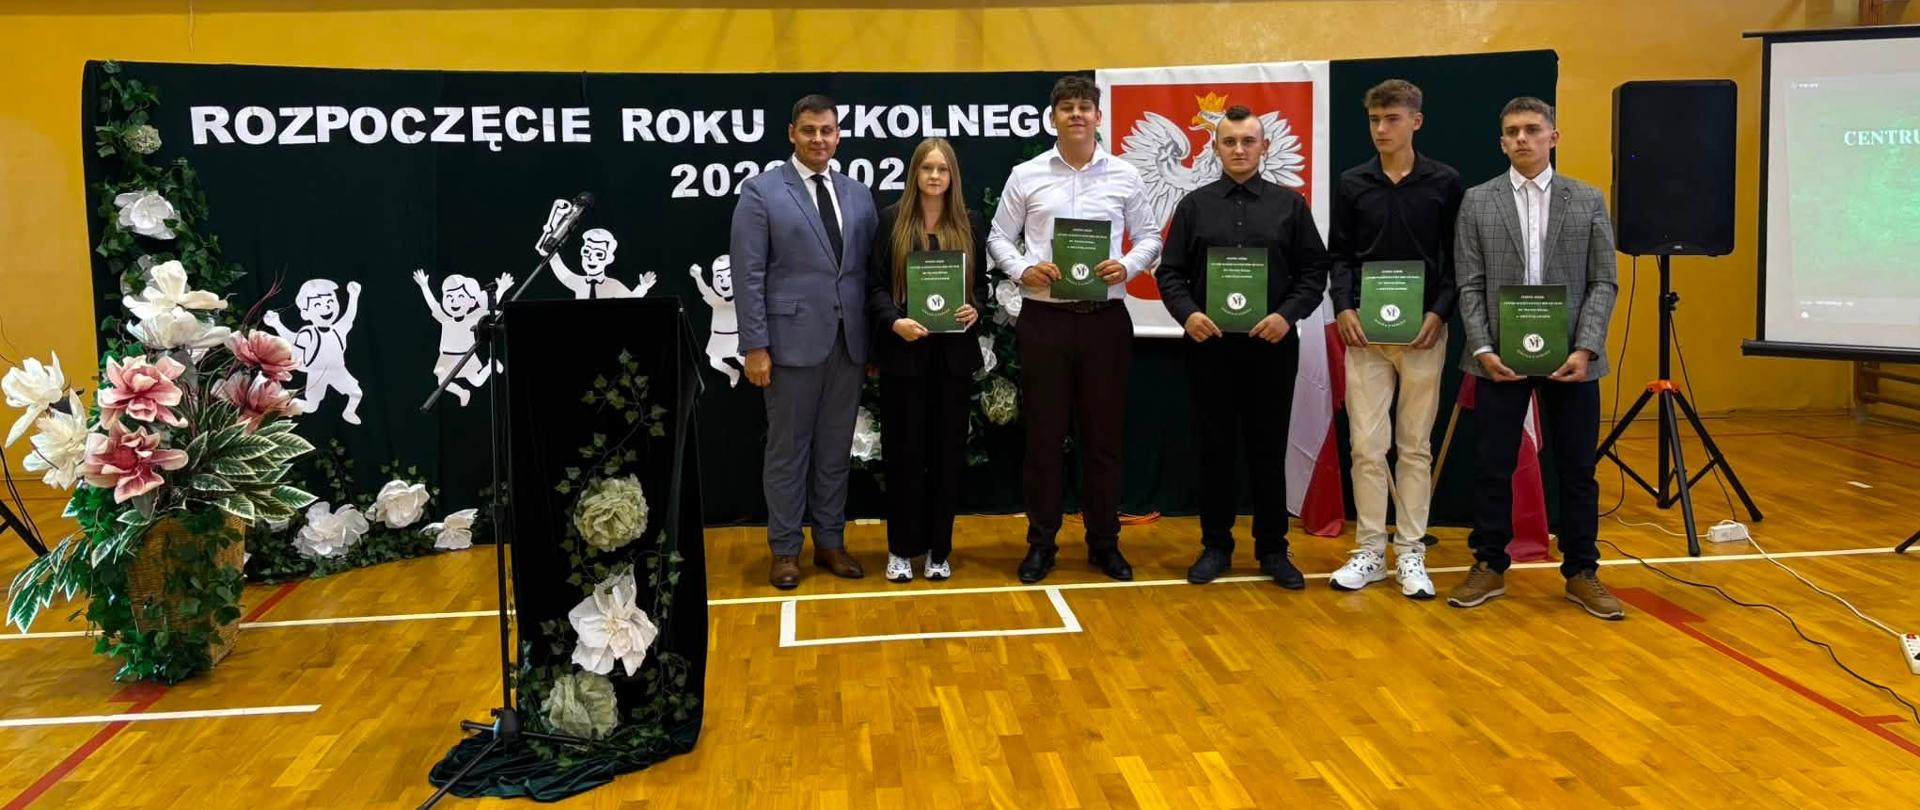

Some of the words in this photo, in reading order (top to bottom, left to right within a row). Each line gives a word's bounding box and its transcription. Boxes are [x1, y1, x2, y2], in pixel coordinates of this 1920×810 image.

[190, 105, 592, 151] ROZPOCZĘCIE
[622, 107, 765, 143] ROKU
[835, 104, 1058, 139] ZKOLNEG
[671, 160, 786, 198] 202
